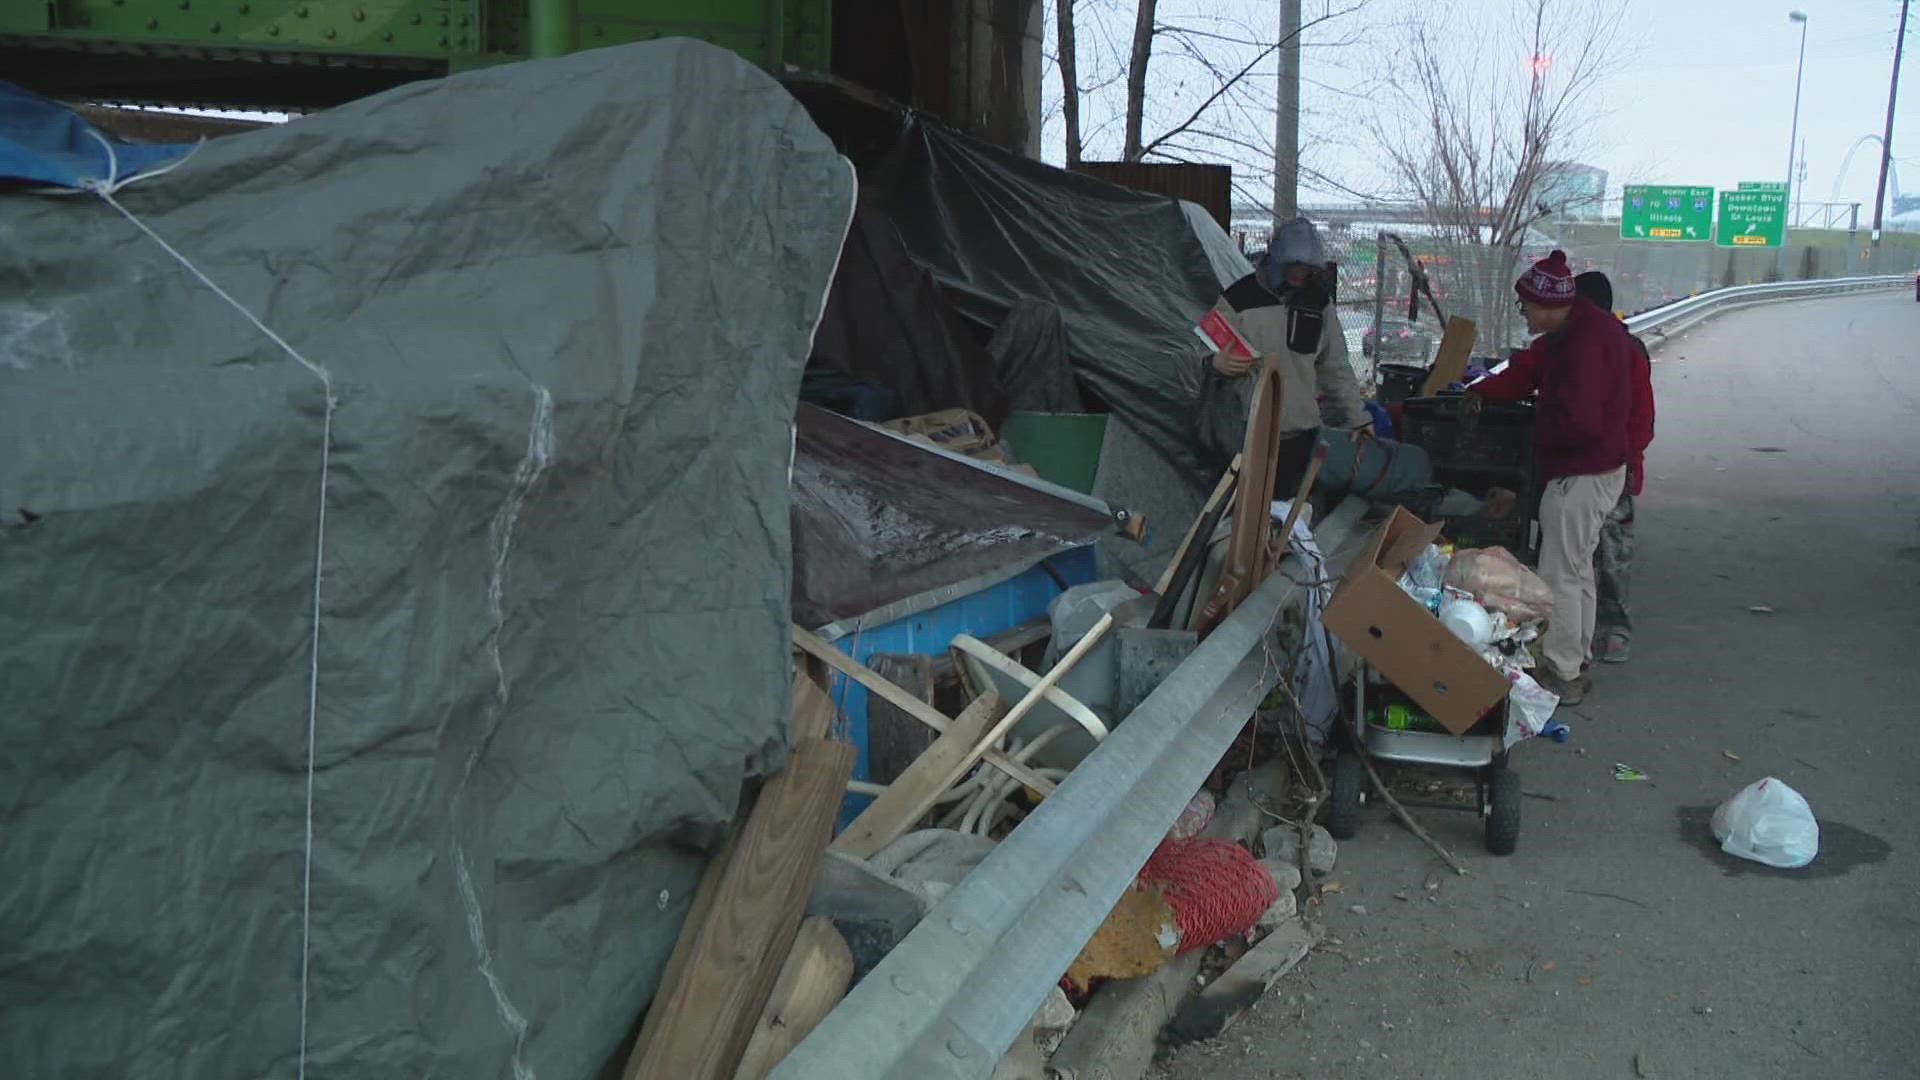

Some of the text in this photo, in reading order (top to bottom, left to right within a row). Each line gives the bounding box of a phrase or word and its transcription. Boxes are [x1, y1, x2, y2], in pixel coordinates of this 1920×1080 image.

[1761, 194, 1783, 202] Blvd
[1650, 200, 1661, 208] TO
[1727, 204, 1776, 212] Downtown
[1649, 213, 1682, 222] Illinois
[1745, 214, 1772, 222] Louis
